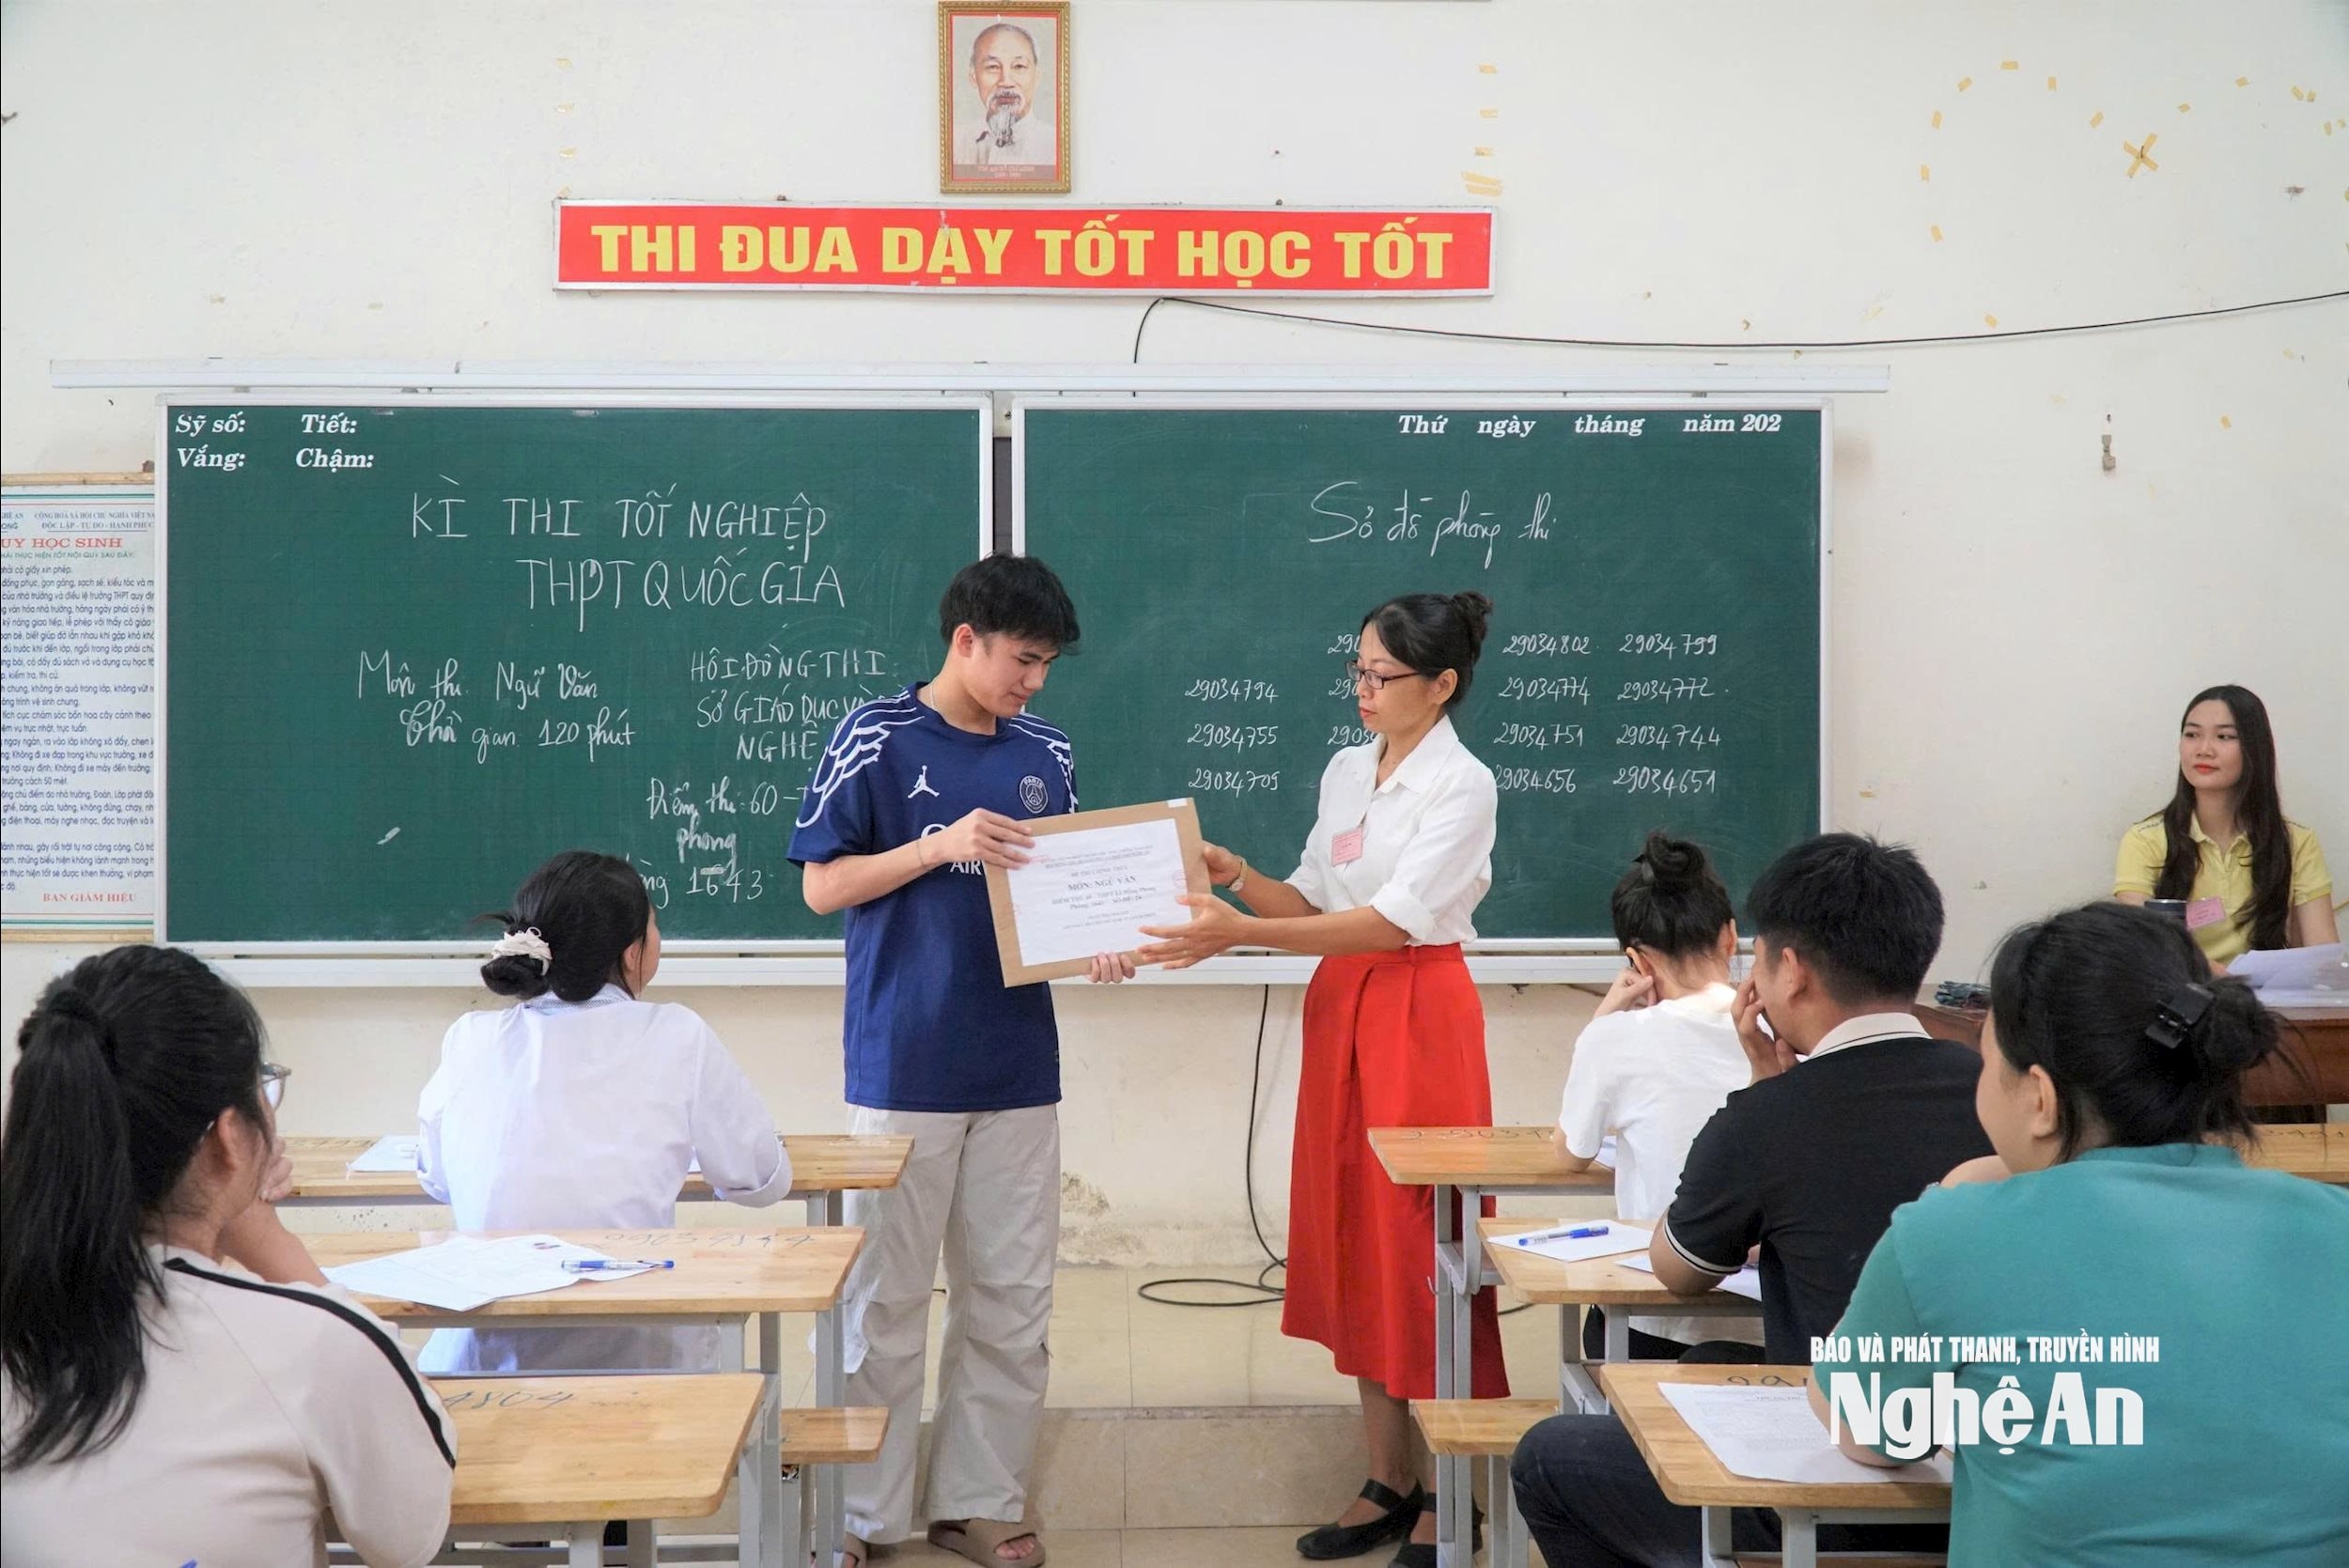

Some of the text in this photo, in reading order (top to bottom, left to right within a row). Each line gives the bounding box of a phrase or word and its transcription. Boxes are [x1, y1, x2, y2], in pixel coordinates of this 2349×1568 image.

[591, 214, 1454, 287] THI ĐUA DẠY TỐT HỌC TỐT
[176, 411, 246, 436] Sỹ số:
[302, 412, 357, 434] Tiết:
[1399, 413, 1781, 437] Thứ ngày tháng năm 202
[177, 444, 246, 471] Vắng:
[296, 448, 374, 473] Chậm:
[413, 474, 826, 563] KÌ THI TỐT NGHIỆP
[31, 537, 70, 550] HỌC
[75, 537, 122, 548] SINH
[516, 547, 845, 632] THPT QUỐC GIA
[1502, 633, 1718, 660] 29034802 29034799
[820, 648, 886, 678] THI
[358, 650, 414, 700] Môn
[496, 661, 545, 710] Ngữ
[558, 663, 598, 700] Văn
[1185, 676, 1715, 705] 29034794 29034774 29034772
[538, 720, 581, 747] 120
[587, 706, 635, 763] phút
[1187, 723, 1279, 753] 29034755
[1493, 722, 1583, 751] 29034751
[1616, 723, 1721, 752] 29034744
[1189, 768, 1280, 798] 29034709
[1612, 766, 1716, 799] 29034651
[43, 892, 68, 903] BAN
